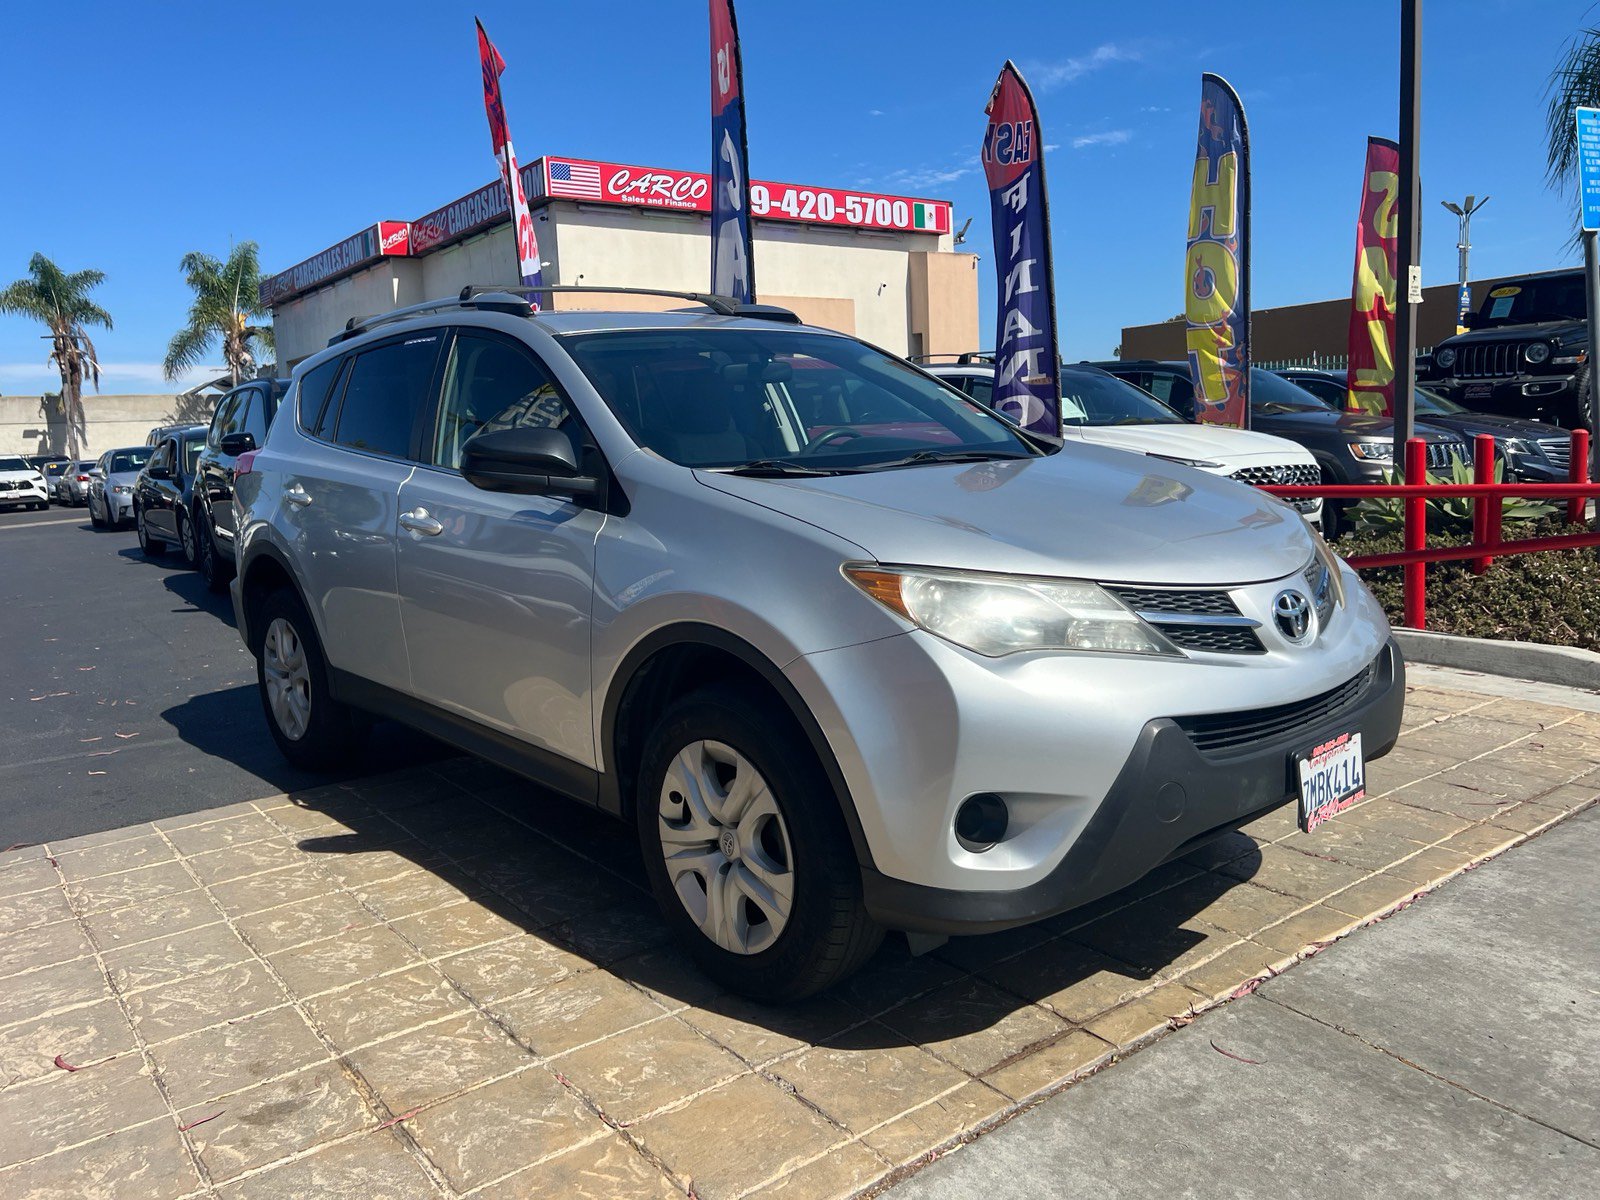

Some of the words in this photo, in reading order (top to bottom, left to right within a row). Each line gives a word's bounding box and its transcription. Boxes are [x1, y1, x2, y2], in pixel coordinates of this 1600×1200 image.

[607, 169, 708, 201] CARCO
[621, 194, 645, 204] Sales
[647, 197, 663, 205] and
[664, 199, 698, 209] Finance
[382, 228, 408, 249] CARCO
[293, 235, 364, 290] CARCOSALES.COM
[1186, 150, 1240, 405] HOT
[1303, 755, 1361, 816] 7MBK414
